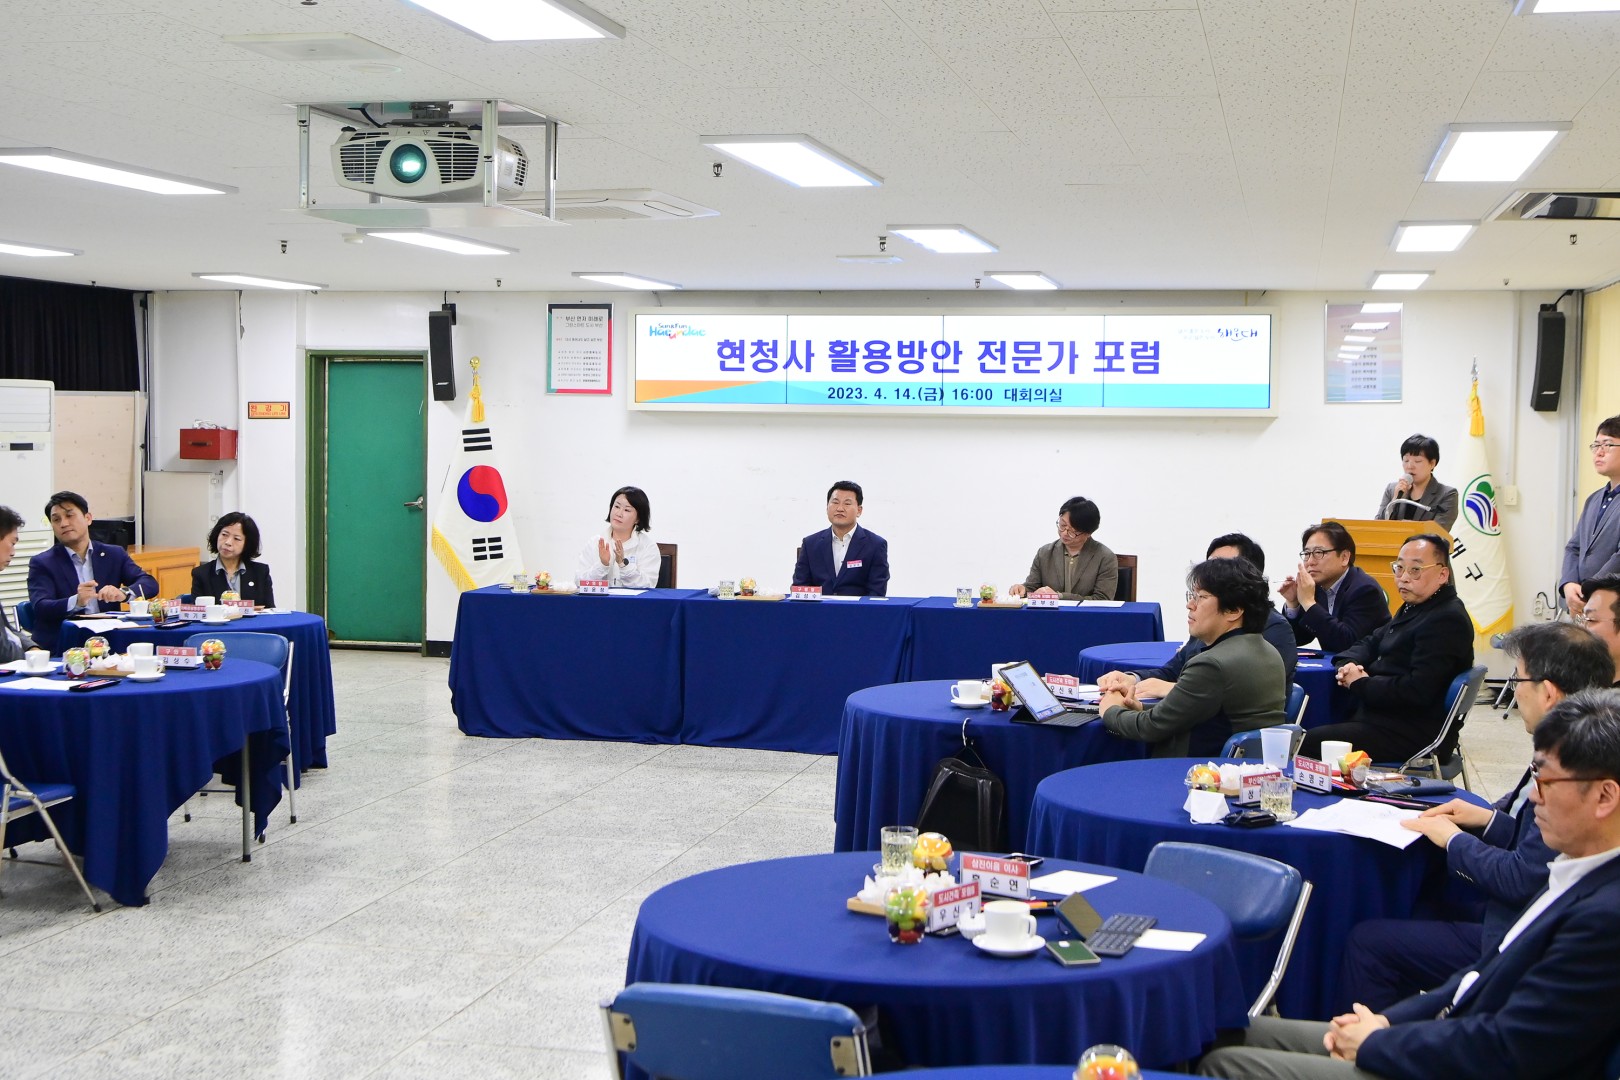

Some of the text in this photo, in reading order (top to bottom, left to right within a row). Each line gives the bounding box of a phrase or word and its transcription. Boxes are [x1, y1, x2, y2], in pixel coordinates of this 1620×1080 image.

[716, 339, 1161, 375] 현청사 활용방안 전문가 포럼
[827, 387, 867, 400] 2023.
[874, 388, 887, 400] 4.
[952, 388, 993, 401] 16:00
[1004, 387, 1063, 403] 대회의실
[1003, 863, 1019, 875] 이사
